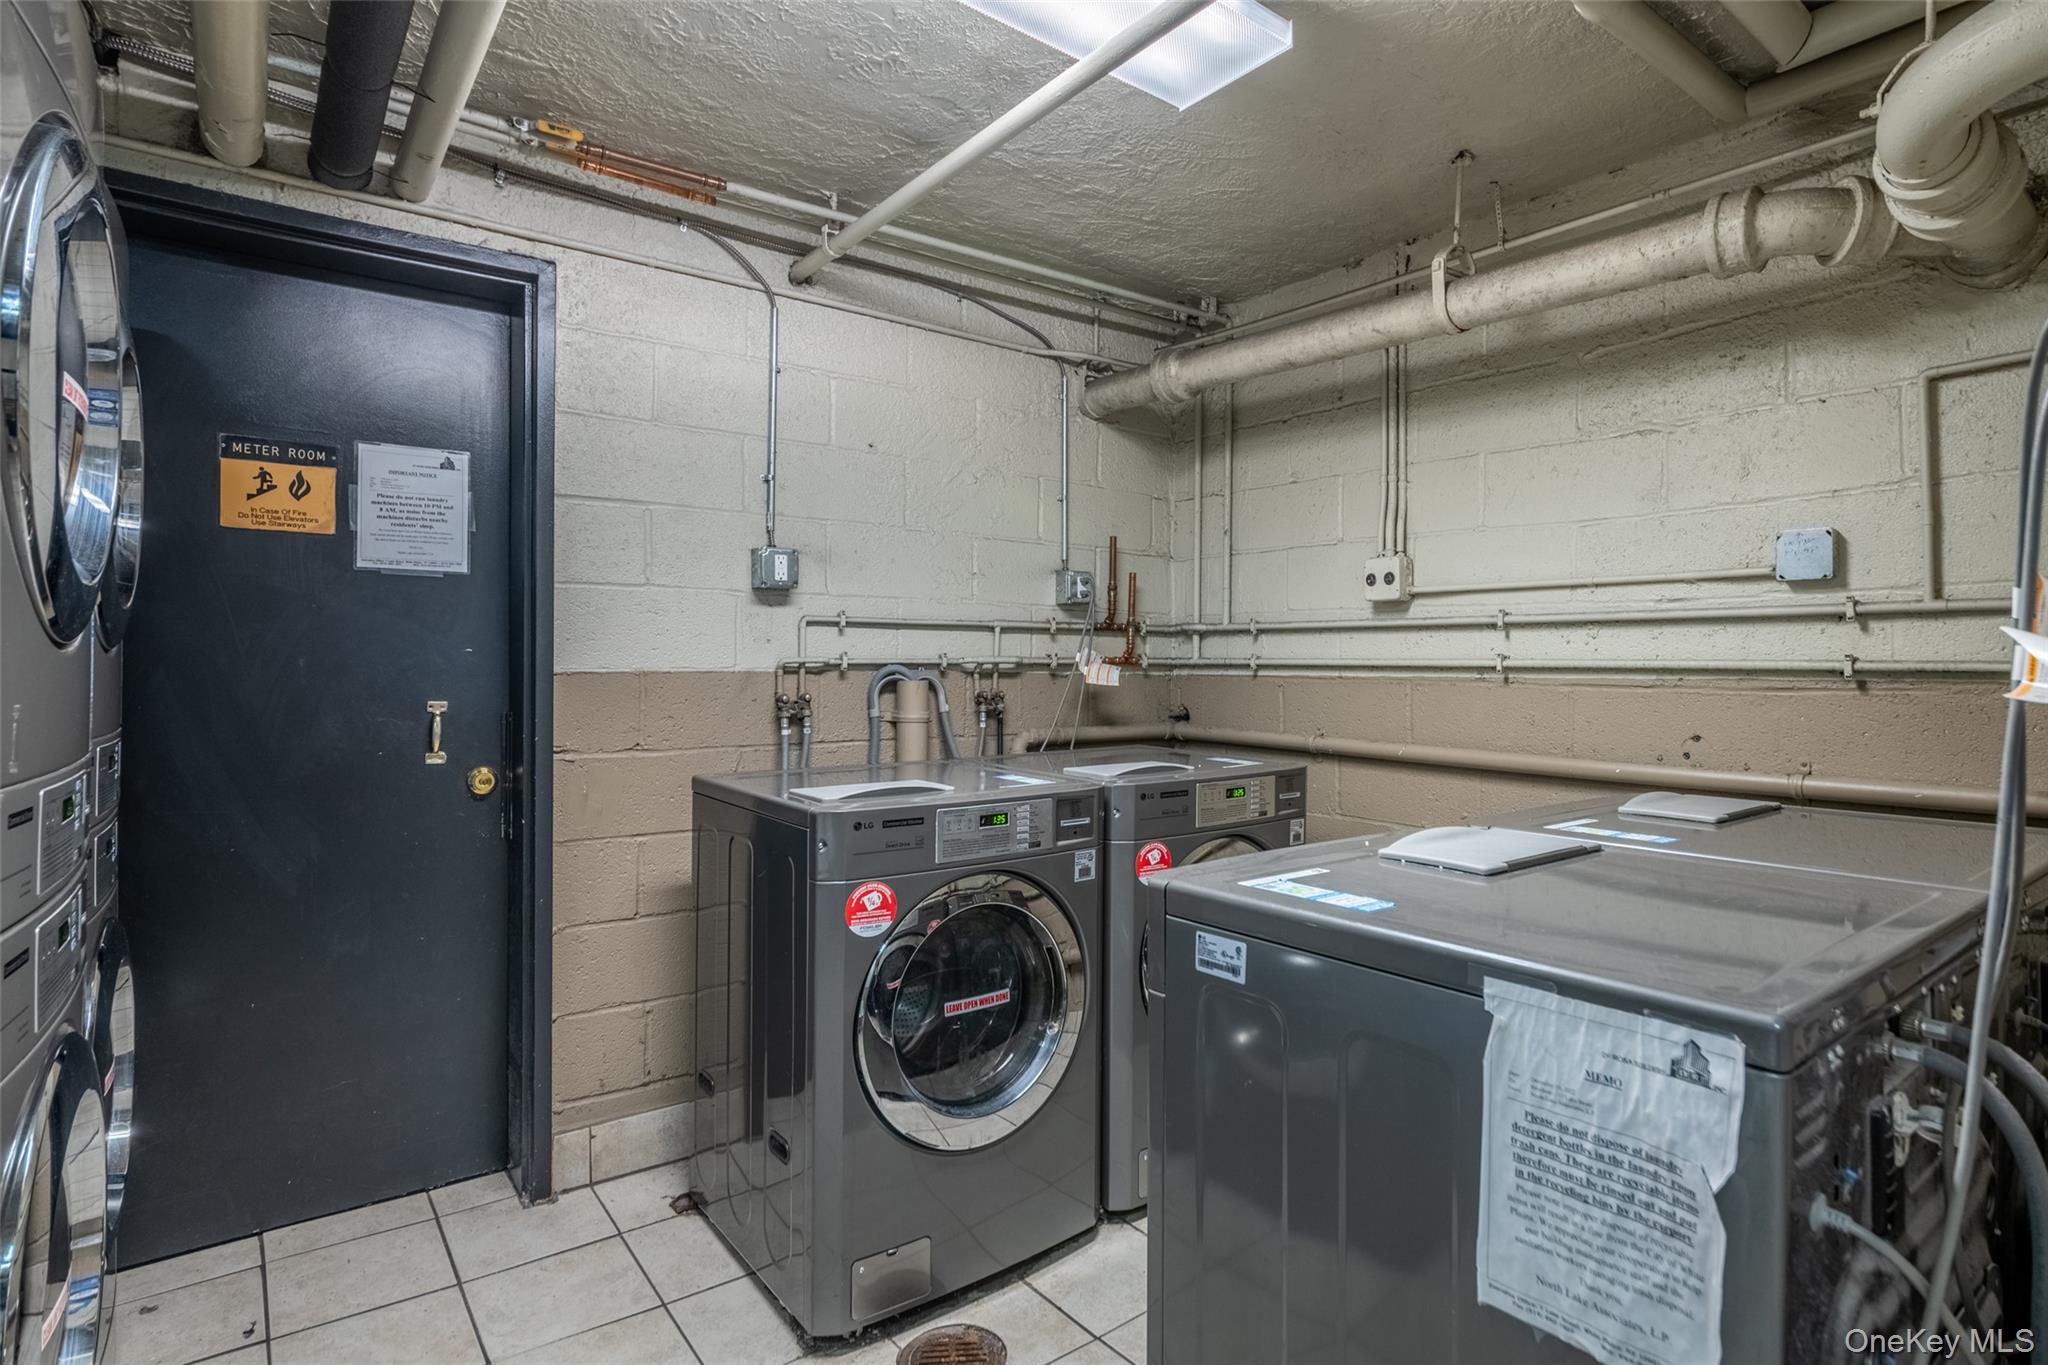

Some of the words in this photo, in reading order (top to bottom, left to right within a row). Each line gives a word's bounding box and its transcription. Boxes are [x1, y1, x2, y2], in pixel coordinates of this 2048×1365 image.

[232, 442, 280, 457] METER
[288, 447, 326, 461] ROOM
[250, 506, 258, 514] In
[259, 507, 280, 515] Case
[281, 508, 291, 517] Of
[292, 509, 308, 517] Fire
[426, 496, 448, 504] laundry
[237, 511, 249, 519] Do
[251, 512, 265, 520] Not
[267, 513, 282, 521] Use
[283, 514, 320, 525] Elevators
[251, 519, 267, 527] Use
[268, 520, 307, 530] Stairways
[946, 1003, 962, 1014] LEAVE
[963, 1000, 978, 1010] OPEN
[979, 995, 995, 1006] WHEN
[996, 991, 1009, 1001] DONE
[1584, 1069, 1623, 1090] MEMO
[1524, 1110, 1555, 1129] Please
[1556, 1121, 1570, 1133] do
[1572, 1128, 1589, 1139] not
[1591, 1133, 1630, 1152] dispose
[1632, 1148, 1643, 1158] of
[1644, 1151, 1683, 1176] laundry
[1511, 1121, 1557, 1144] detergent
[1559, 1136, 1593, 1157] bottles
[1594, 1149, 1605, 1161] in
[1607, 1154, 1625, 1168] the
[1628, 1159, 1667, 1183] laundry
[1671, 1180, 1697, 1200] room
[1510, 1136, 1536, 1152] trash
[1538, 1146, 1561, 1161] cans.
[1564, 1152, 1594, 1174] These
[1596, 1168, 1615, 1180] are
[1617, 1175, 1669, 1201] recyclable
[1672, 1192, 1700, 1216] items
[1512, 1150, 1558, 1176] therefore
[1560, 1170, 1584, 1186] must
[1586, 1177, 1598, 1191] be
[1601, 1184, 1636, 1203] rinsed
[1659, 1206, 1677, 1222] and
[1514, 1166, 1525, 1178] in
[1527, 1171, 1544, 1184] the
[1545, 1178, 1590, 1206] recycling
[1591, 1194, 1614, 1211] bins
[1615, 1203, 1629, 1217] by
[1632, 1209, 1651, 1224] the
[1535, 1273, 1564, 1296] North
[1564, 1287, 1590, 1309] Lake
[1591, 1300, 1648, 1337] Associates,
